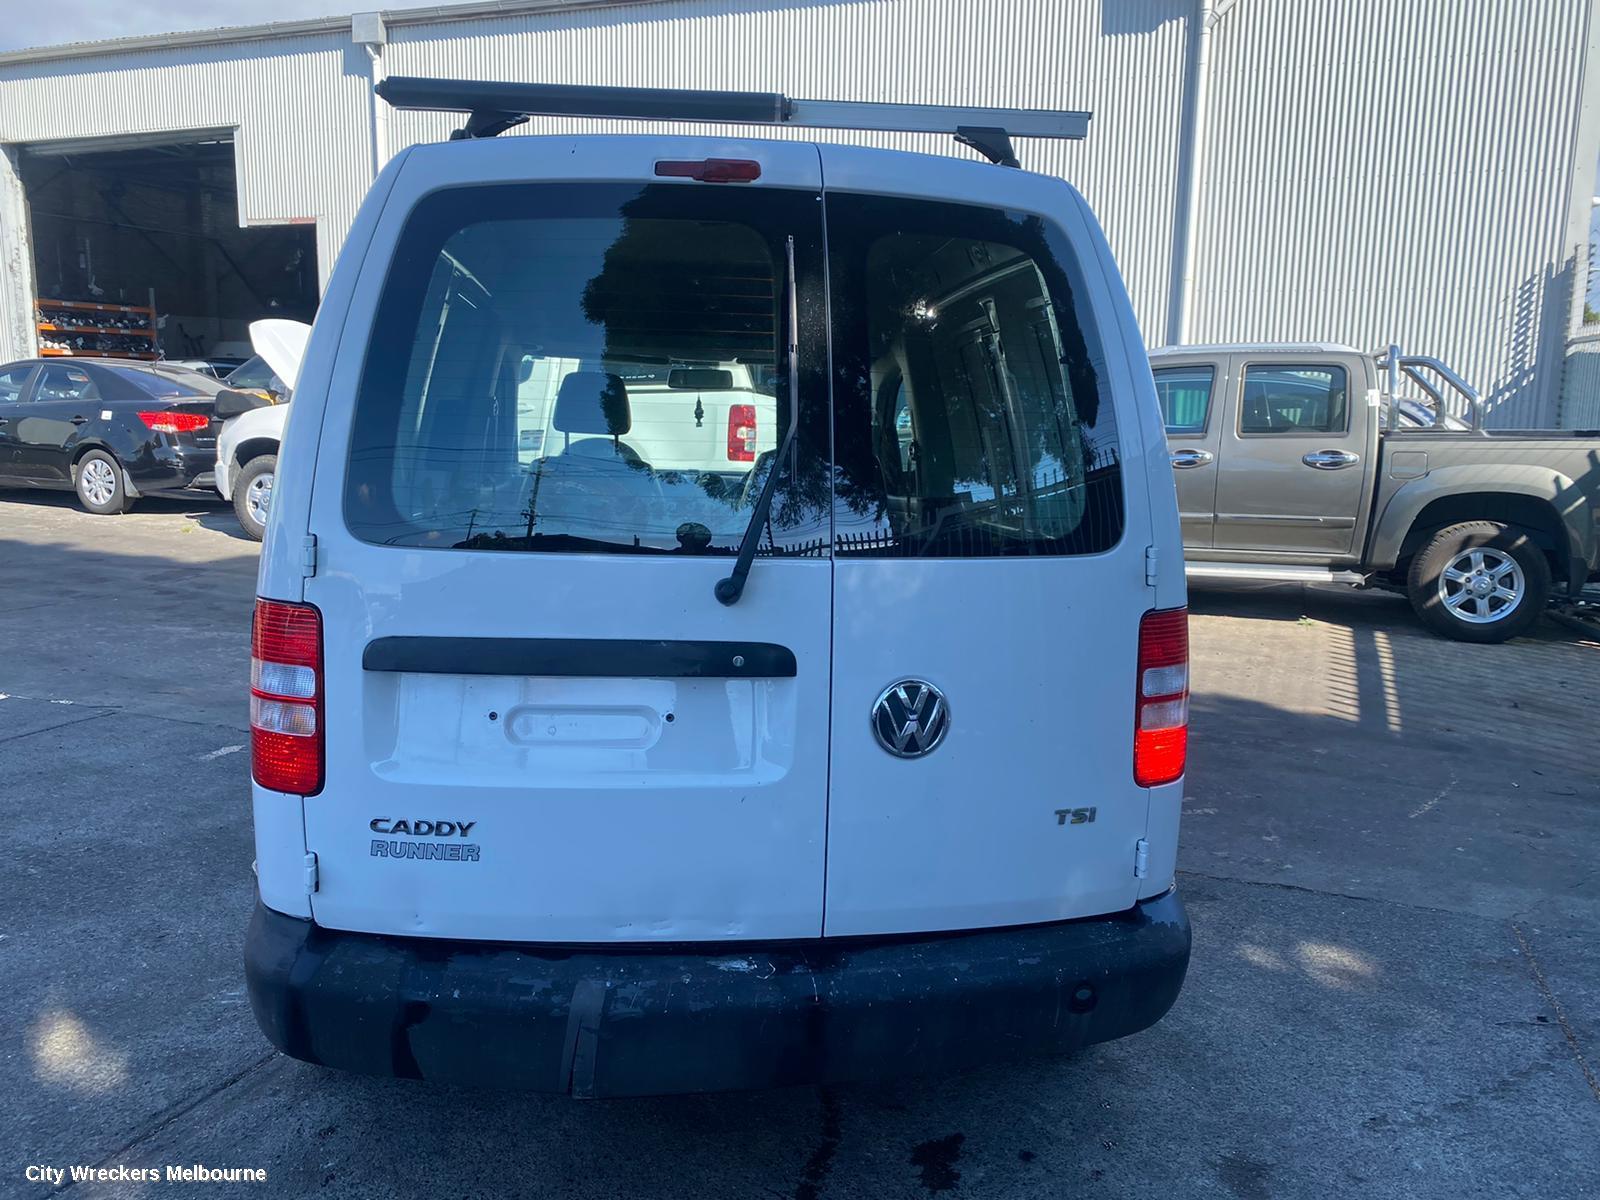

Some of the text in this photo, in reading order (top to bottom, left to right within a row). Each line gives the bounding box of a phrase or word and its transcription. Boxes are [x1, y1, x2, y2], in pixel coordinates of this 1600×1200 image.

[1054, 807, 1097, 825] TSI
[369, 818, 477, 837] CADDY
[370, 839, 481, 862] RUNNER
